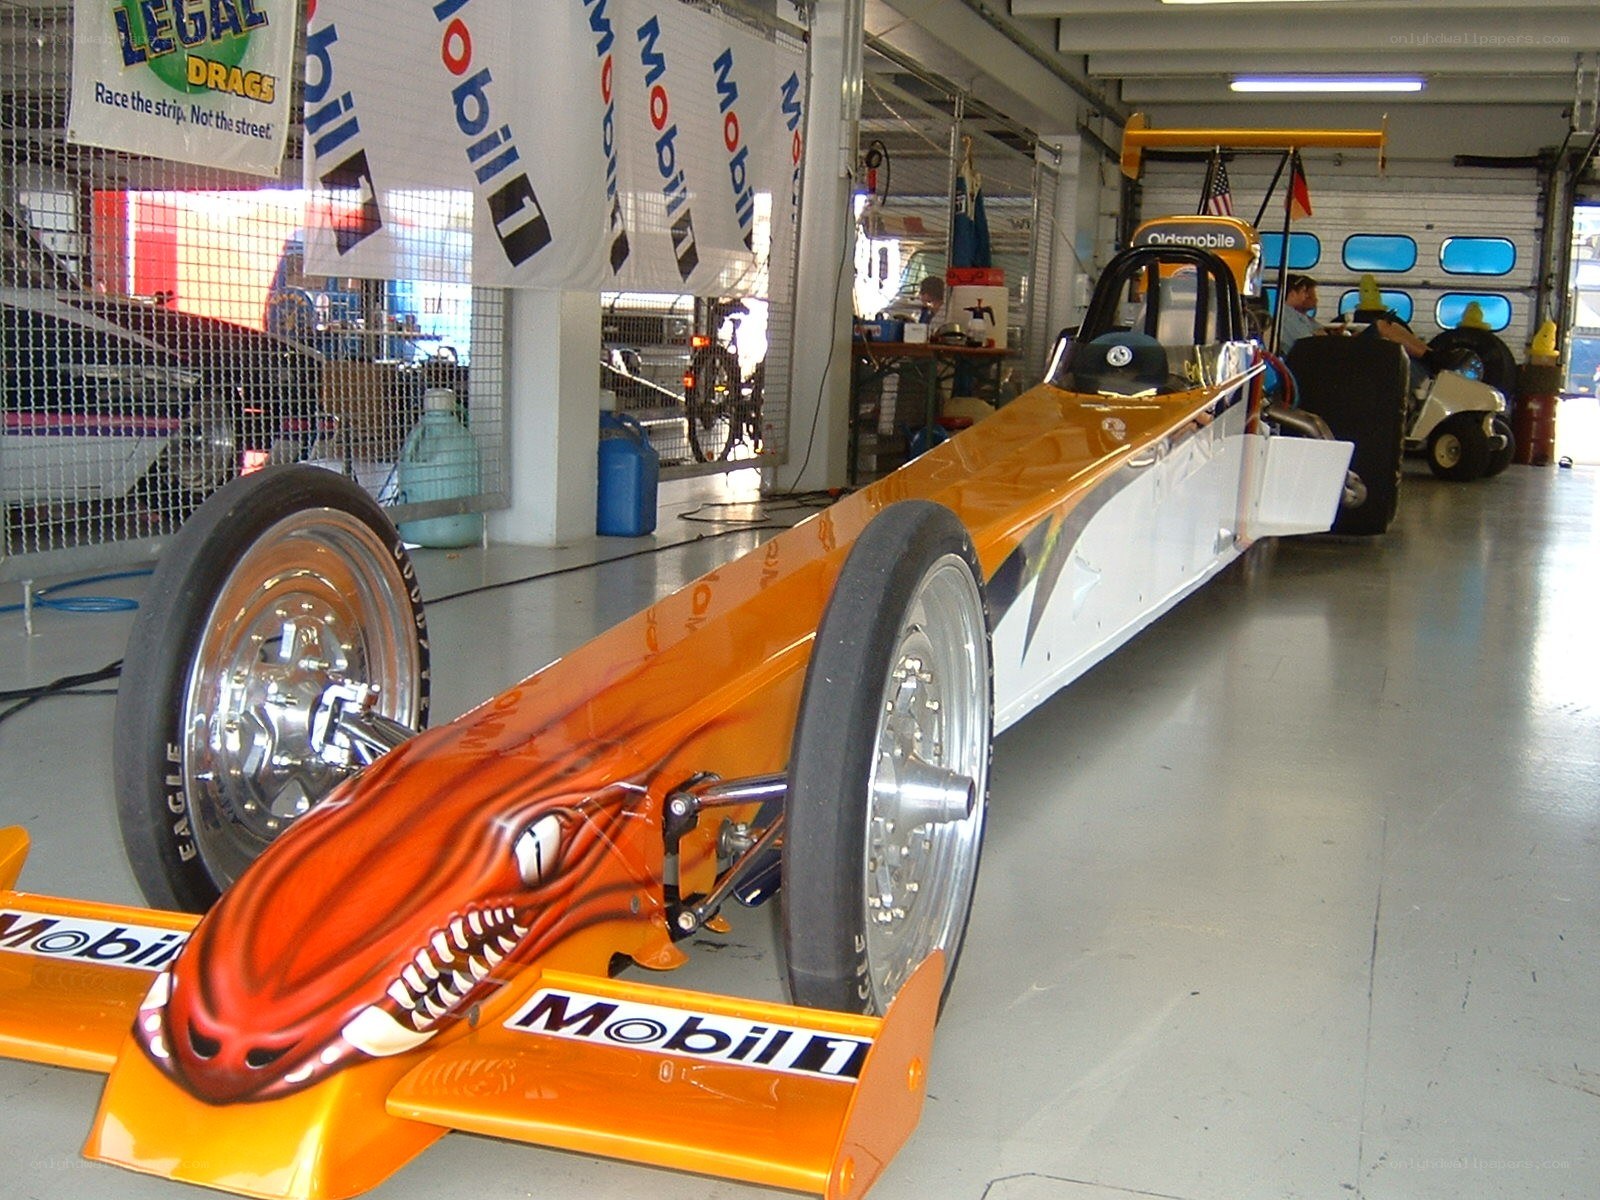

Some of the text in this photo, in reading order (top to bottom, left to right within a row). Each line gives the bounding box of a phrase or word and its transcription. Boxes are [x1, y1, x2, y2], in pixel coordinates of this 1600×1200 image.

[113, 0, 270, 66] LEGAL
[95, 82, 129, 110] Race
[131, 91, 153, 115] the
[155, 100, 186, 125] strip.
[190, 104, 214, 128] Not
[215, 111, 233, 132] the
[187, 55, 275, 104] DRAGS
[304, 0, 360, 160] bil
[637, 14, 688, 218] Mobil
[433, 0, 553, 268] obil 1
[713, 47, 756, 229] Mobil
[1148, 233, 1235, 247] Oldsmobile
[165, 742, 197, 862] EAGLE
[0, 913, 187, 967] Mobil
[515, 993, 872, 1079] Mobil 1
